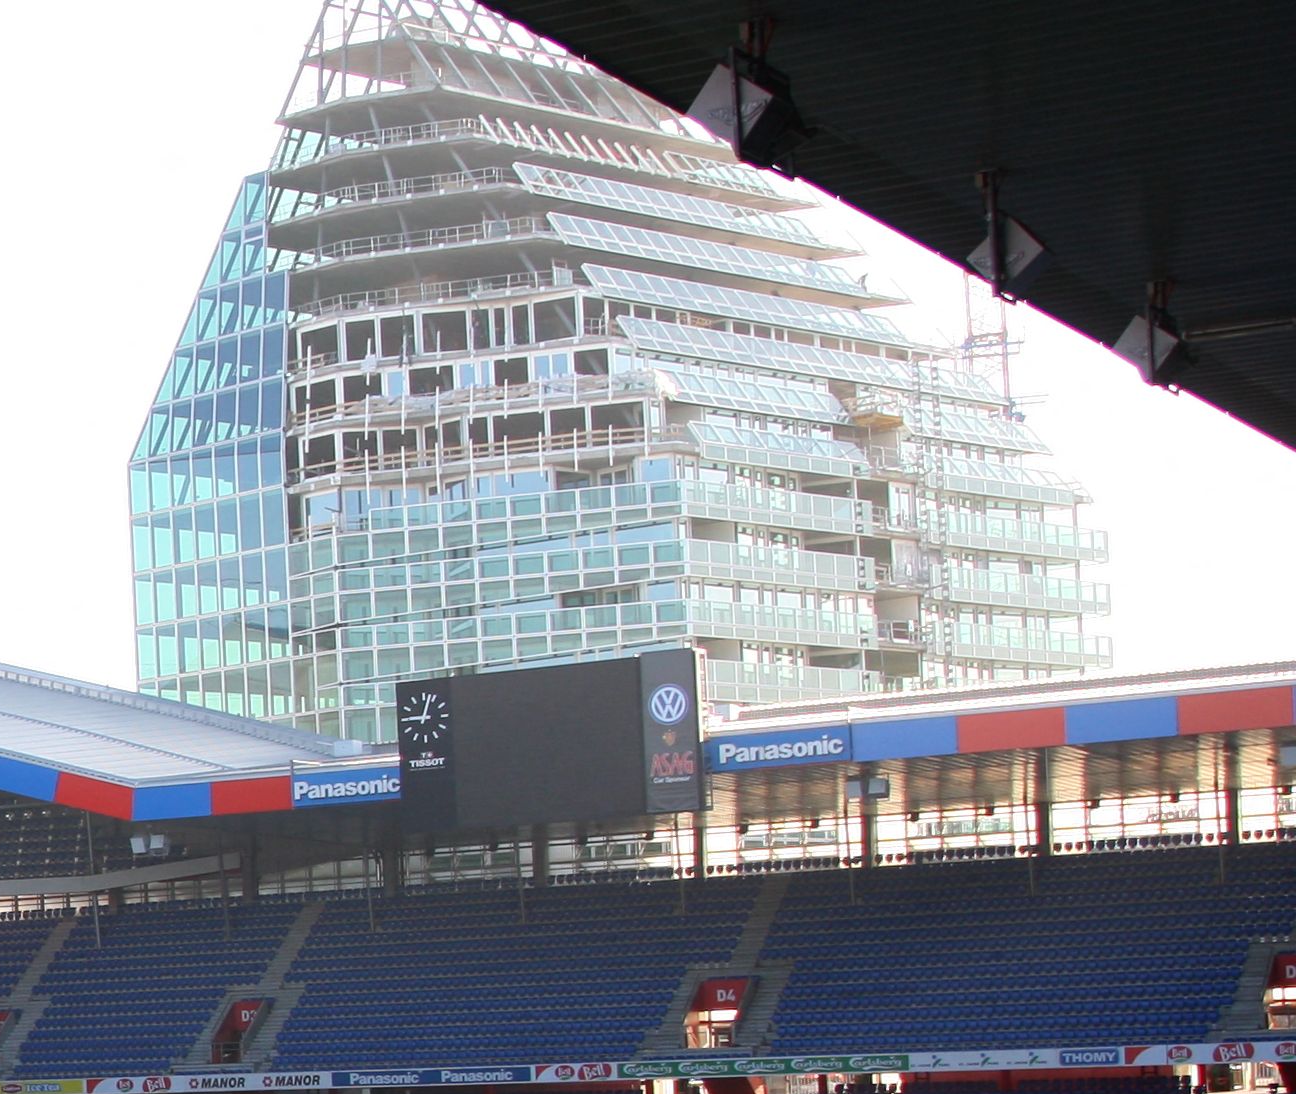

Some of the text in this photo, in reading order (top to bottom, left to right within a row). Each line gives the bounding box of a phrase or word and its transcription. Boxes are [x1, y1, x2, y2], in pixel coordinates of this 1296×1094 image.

[719, 734, 844, 764] Panasonic
[409, 757, 445, 768] TISSOT
[650, 751, 694, 777] ASAG
[294, 775, 401, 800] Panasonic
[716, 989, 735, 1001] D4
[1063, 1051, 1117, 1064] THOMY
[1219, 1044, 1245, 1062] Bell
[584, 1064, 606, 1080] Bell
[623, 1062, 672, 1076] Carlsberg
[678, 1061, 728, 1075] Carlsberg
[734, 1060, 785, 1073] Carlsberg
[791, 1057, 843, 1071] Carlsberg
[849, 1056, 902, 1070] Carlsberg
[201, 1075, 320, 1089] MANOR MANOR
[349, 1069, 513, 1085] Panasonic Panasonic
[26, 1084, 42, 1092] Ice
[42, 1083, 59, 1091] Tea
[146, 1078, 166, 1093] Bell
